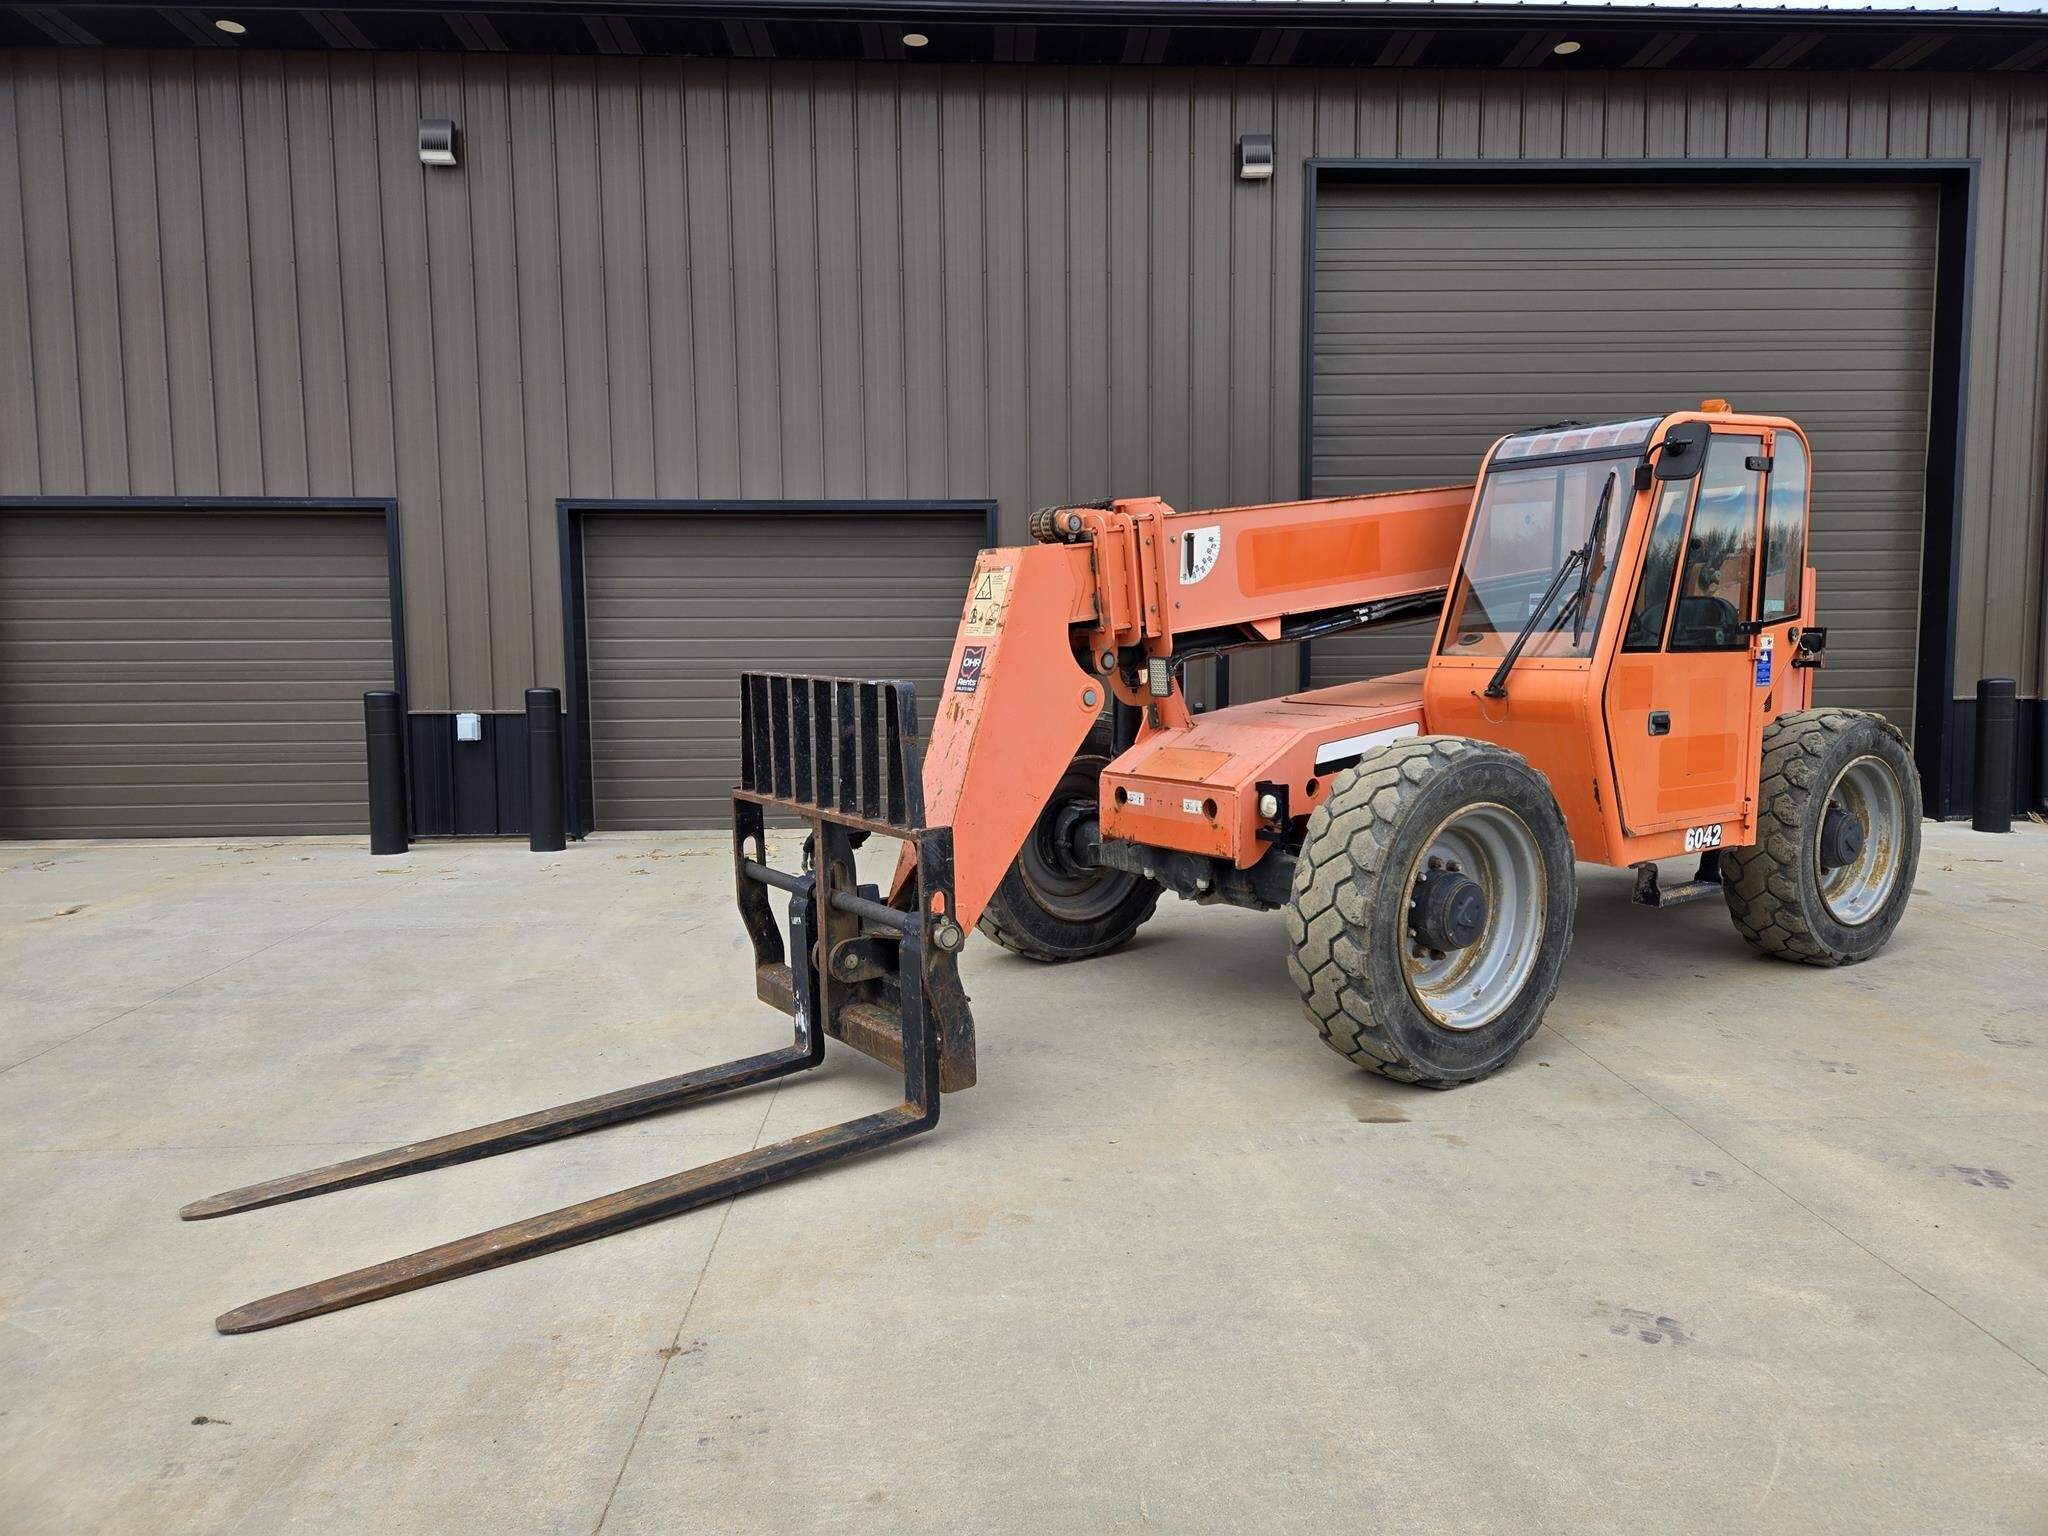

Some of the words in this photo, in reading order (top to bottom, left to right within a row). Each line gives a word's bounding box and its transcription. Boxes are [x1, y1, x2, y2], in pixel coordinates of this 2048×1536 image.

[963, 658, 981, 667] OHR
[957, 678, 976, 686] Rents
[1684, 824, 1722, 852] 6042
